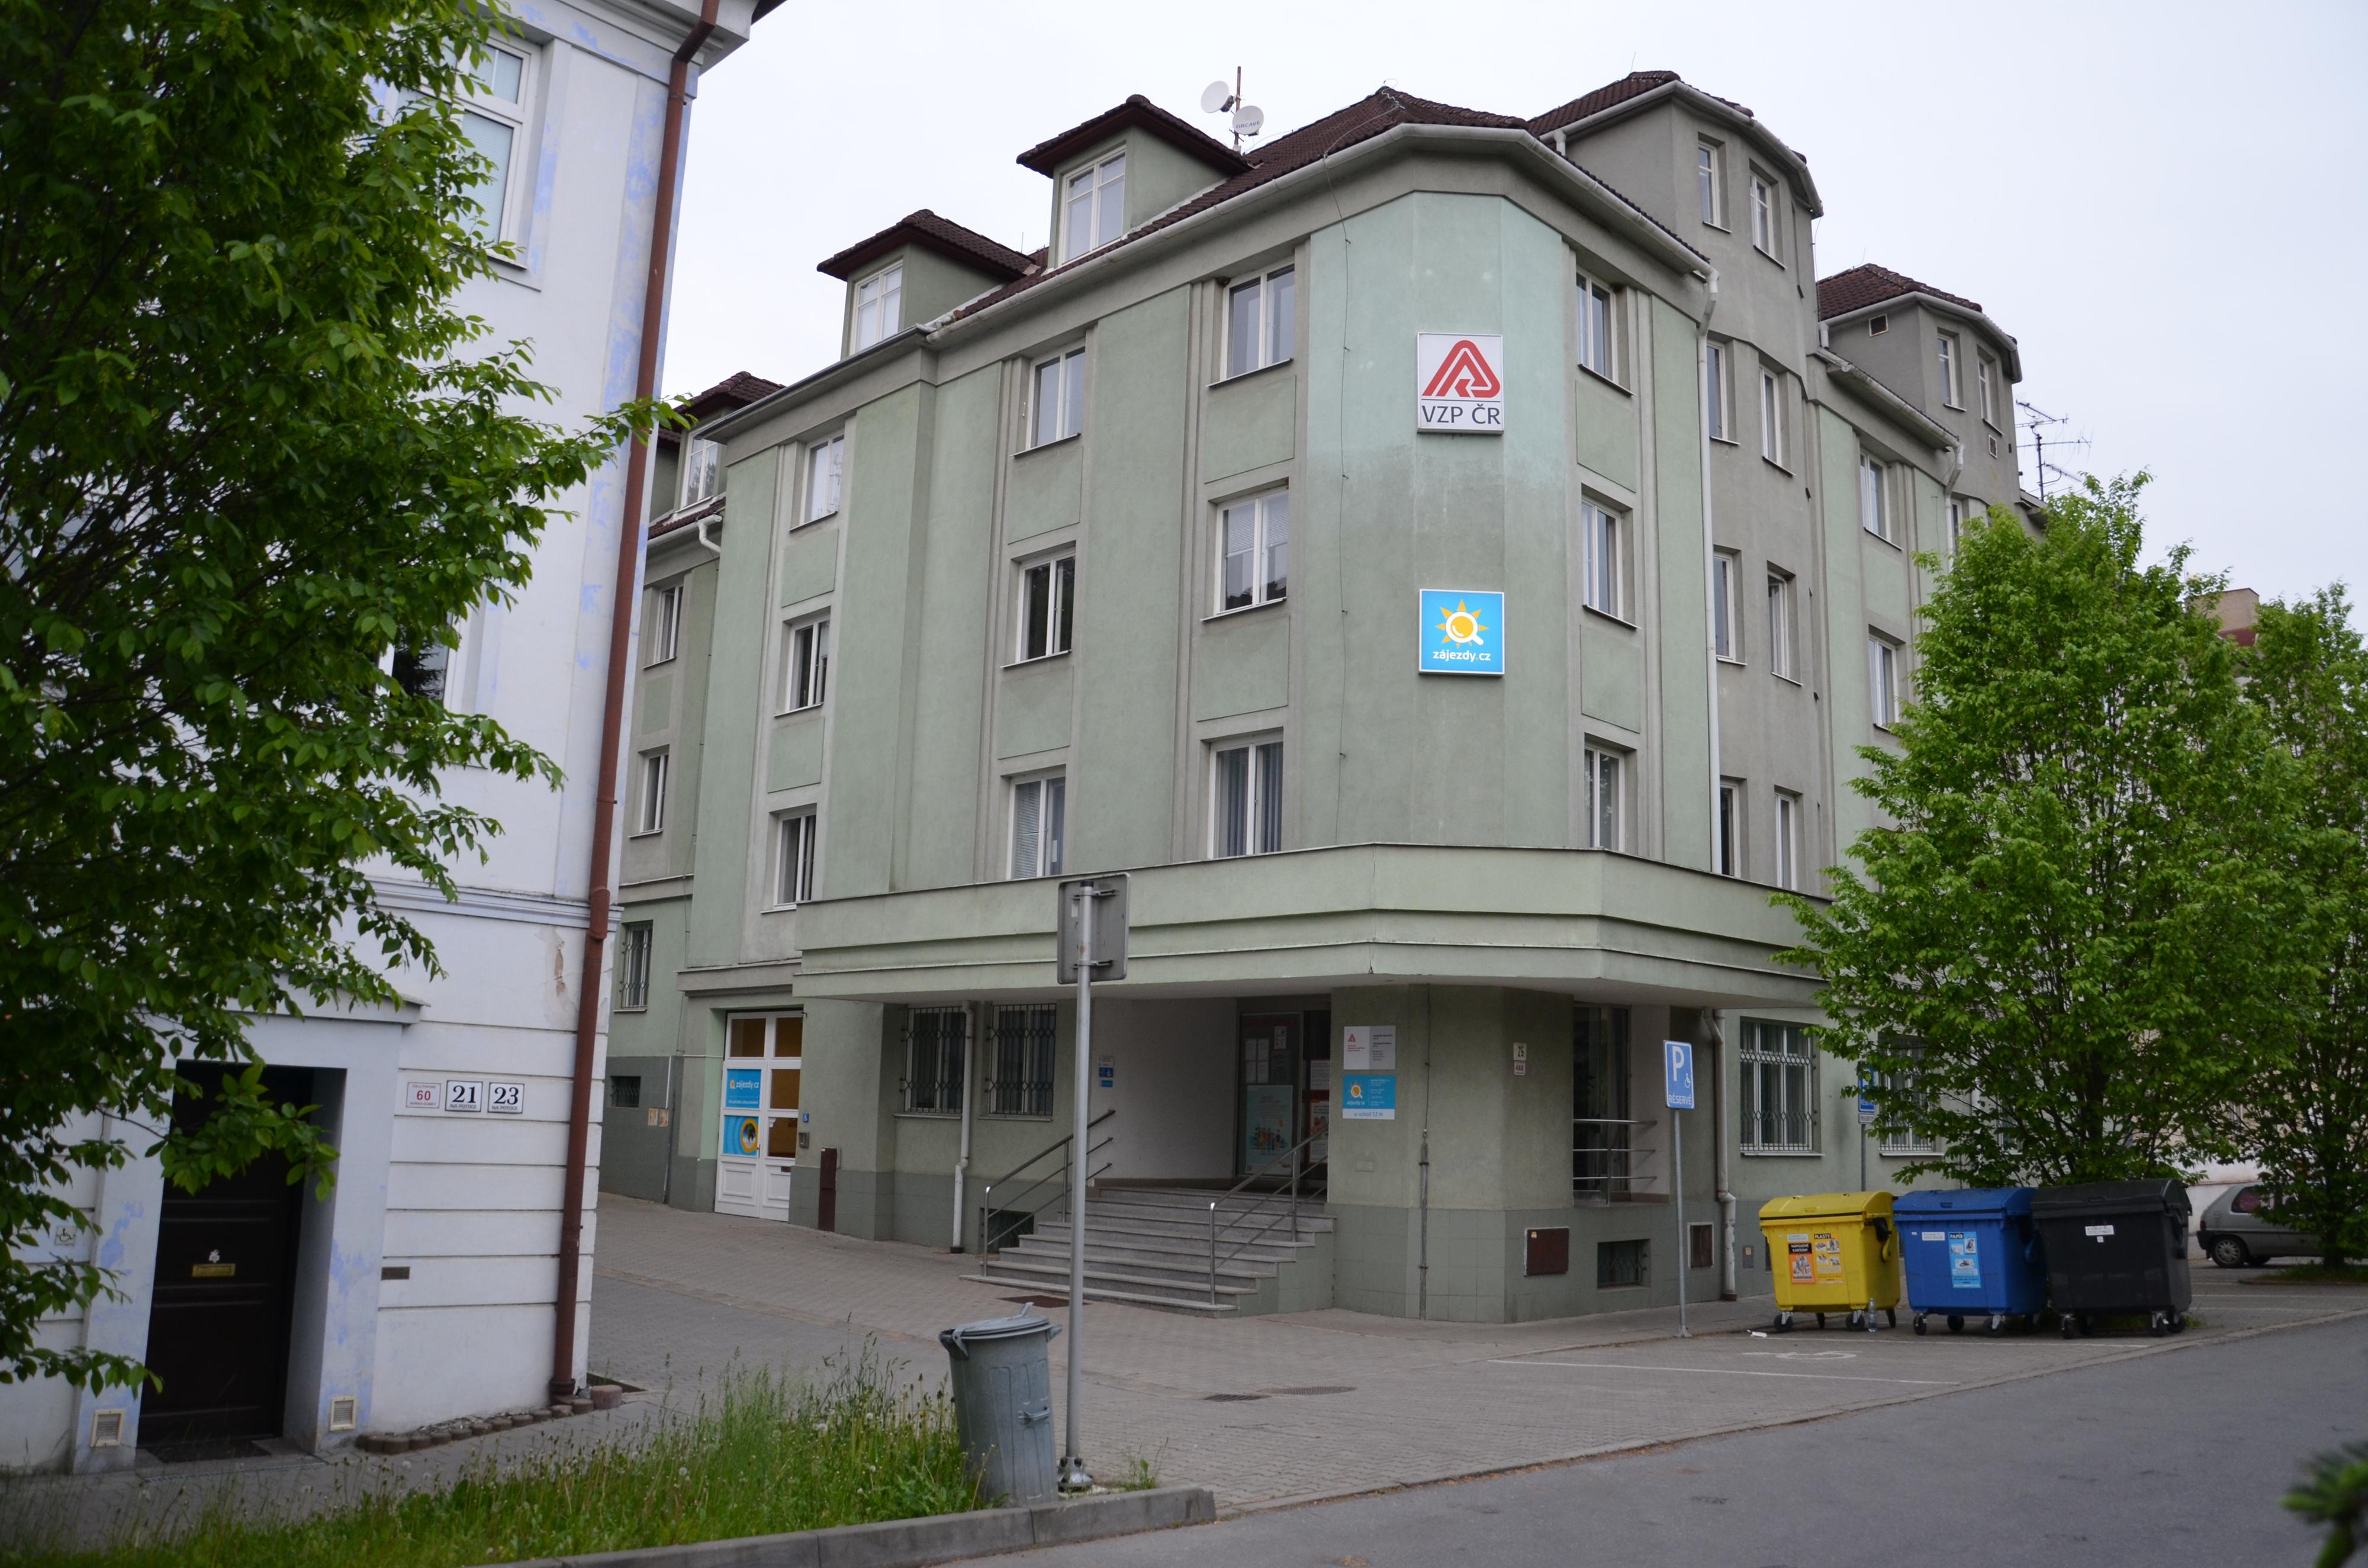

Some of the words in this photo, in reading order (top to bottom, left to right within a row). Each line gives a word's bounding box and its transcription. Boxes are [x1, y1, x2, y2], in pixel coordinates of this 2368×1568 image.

[1421, 405, 1463, 423] VZP
[1472, 403, 1501, 424] ČR
[1433, 649, 1491, 662] zájezdy.cz
[1518, 1046, 1524, 1057] 25
[1672, 1045, 1685, 1081] P
[417, 1090, 431, 1101] 60
[452, 1085, 476, 1103] 21
[493, 1087, 519, 1105] 23
[1668, 1092, 1693, 1106] RÉSERVÉ
